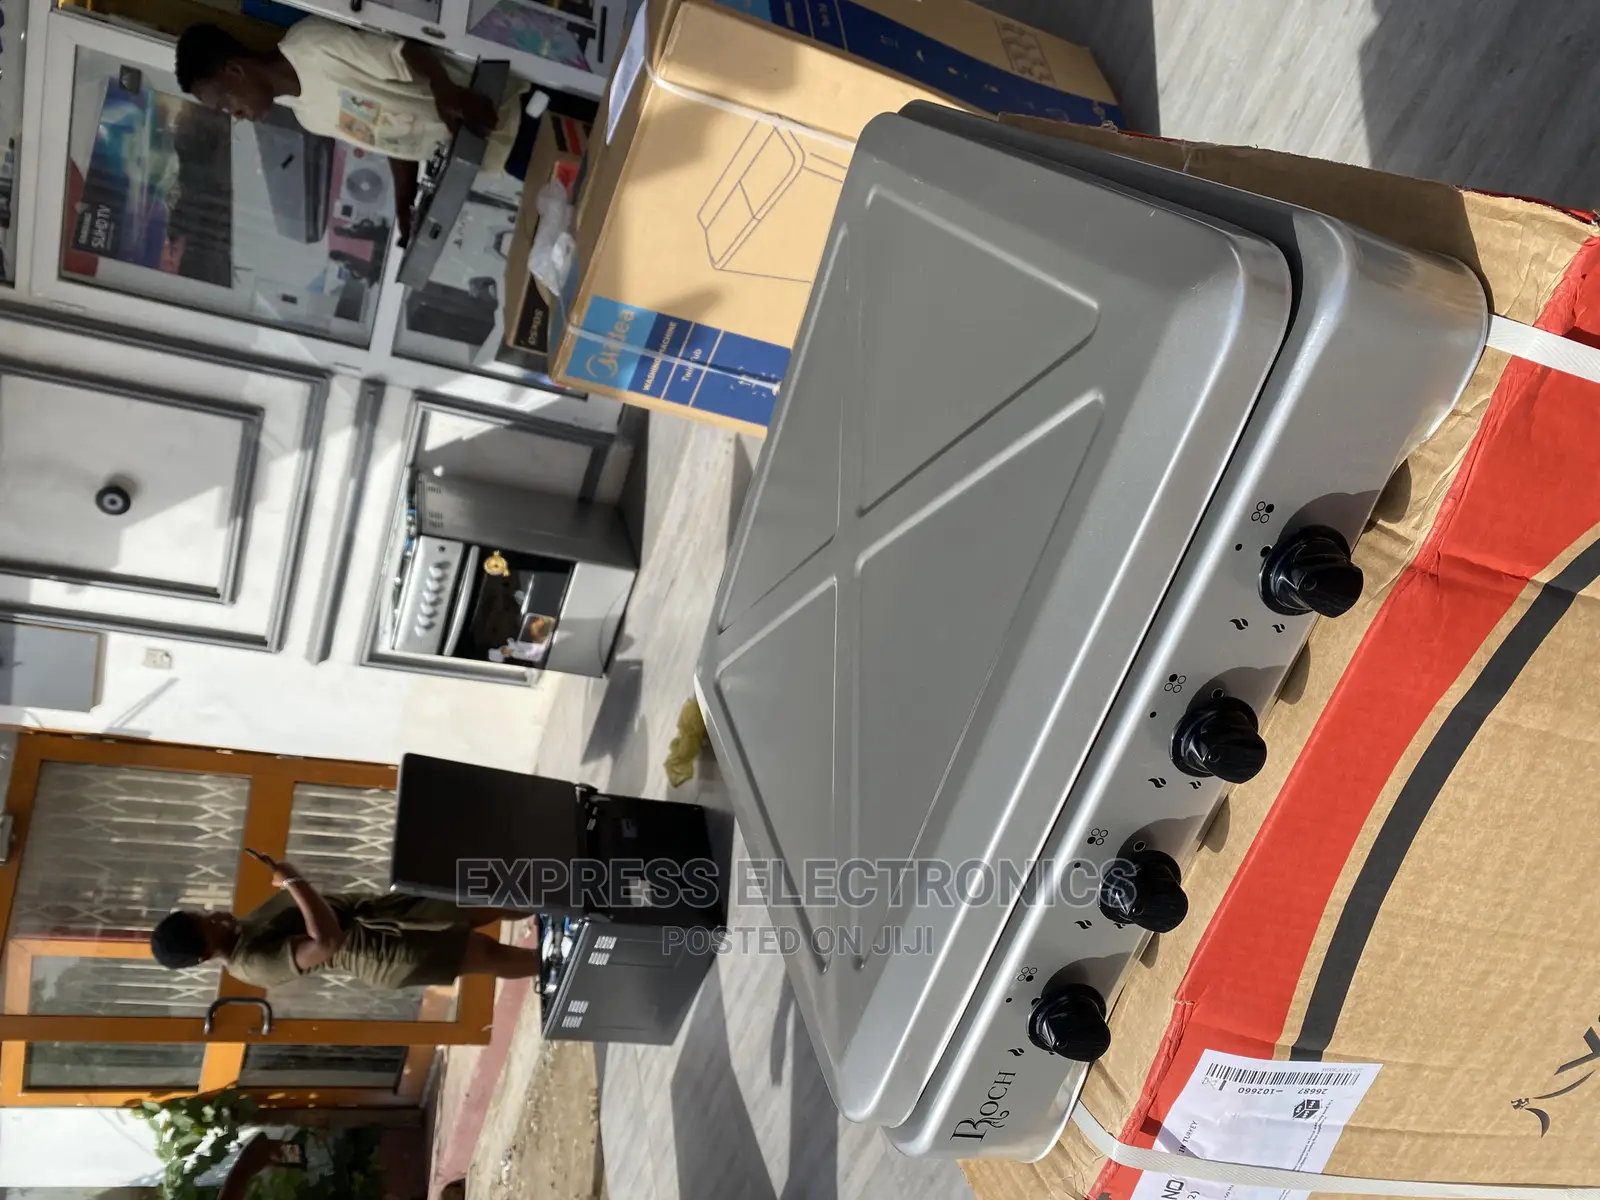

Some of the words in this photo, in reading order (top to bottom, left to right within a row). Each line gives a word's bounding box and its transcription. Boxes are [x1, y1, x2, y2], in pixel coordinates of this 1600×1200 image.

[96, 204, 112, 218] TV
[91, 218, 108, 248] SUHD
[586, 310, 635, 378] Midea
[949, 1070, 1016, 1142] ROCH
[1182, 1120, 1198, 1143] TURKEY
[1178, 1144, 1187, 1153] IN
